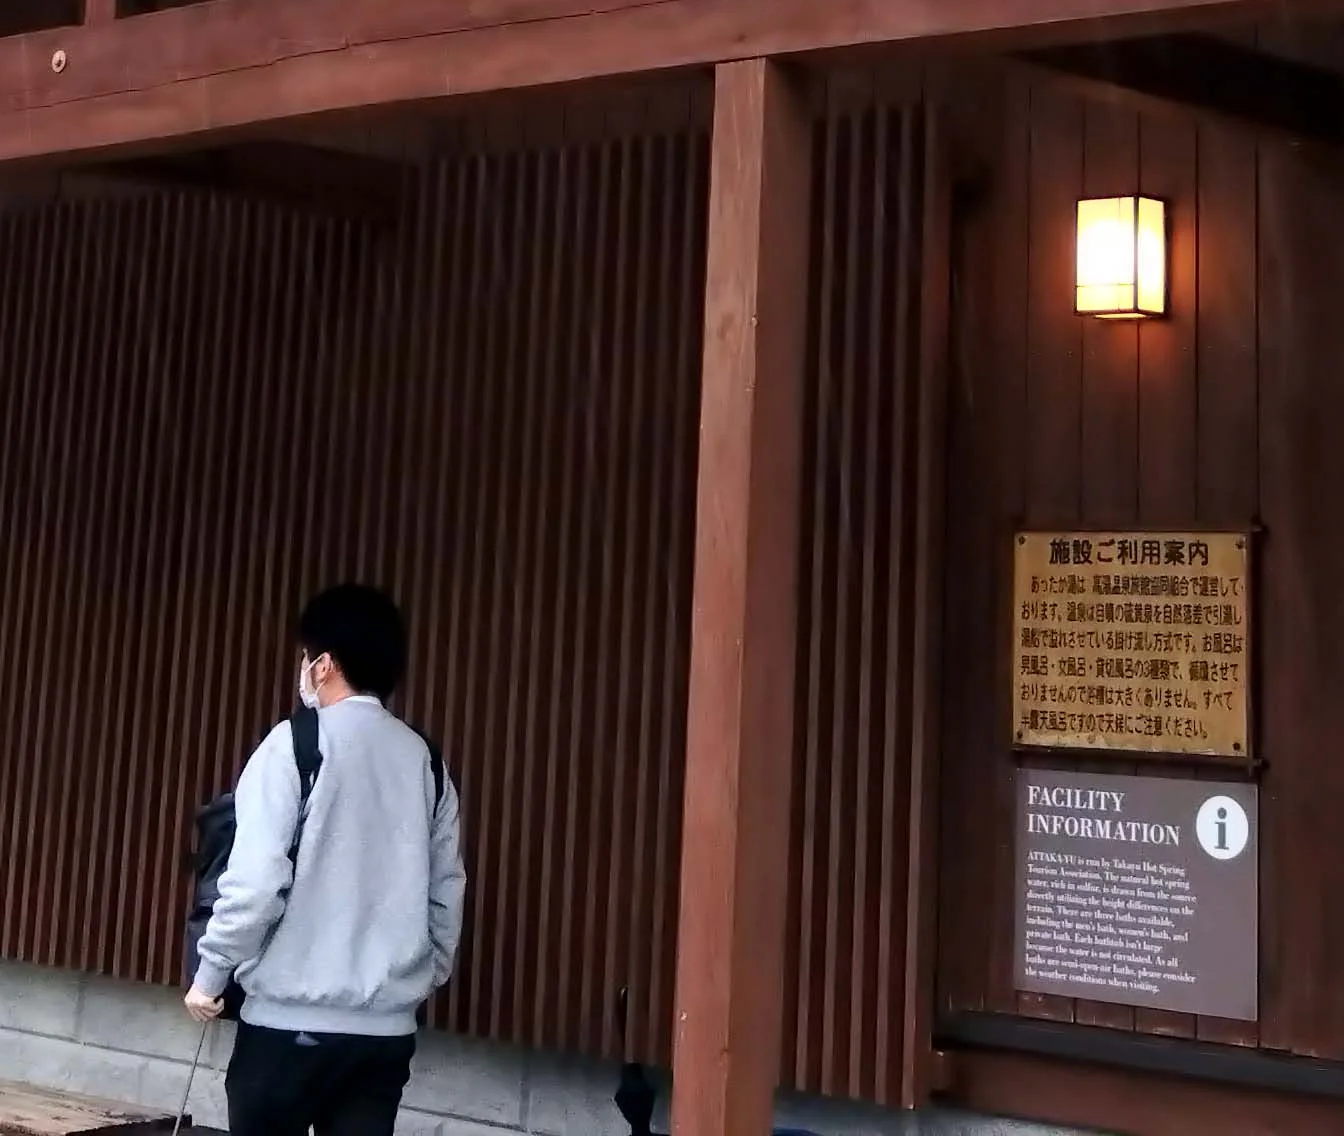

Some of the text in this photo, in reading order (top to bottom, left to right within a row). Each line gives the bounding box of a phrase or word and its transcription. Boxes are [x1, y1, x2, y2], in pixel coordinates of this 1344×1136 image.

[1049, 538, 1209, 565] 施設ご利用案内
[1027, 785, 1124, 812] FACILITY
[1026, 813, 1181, 847] INFORMATION
[1159, 863, 1184, 877] Spring
